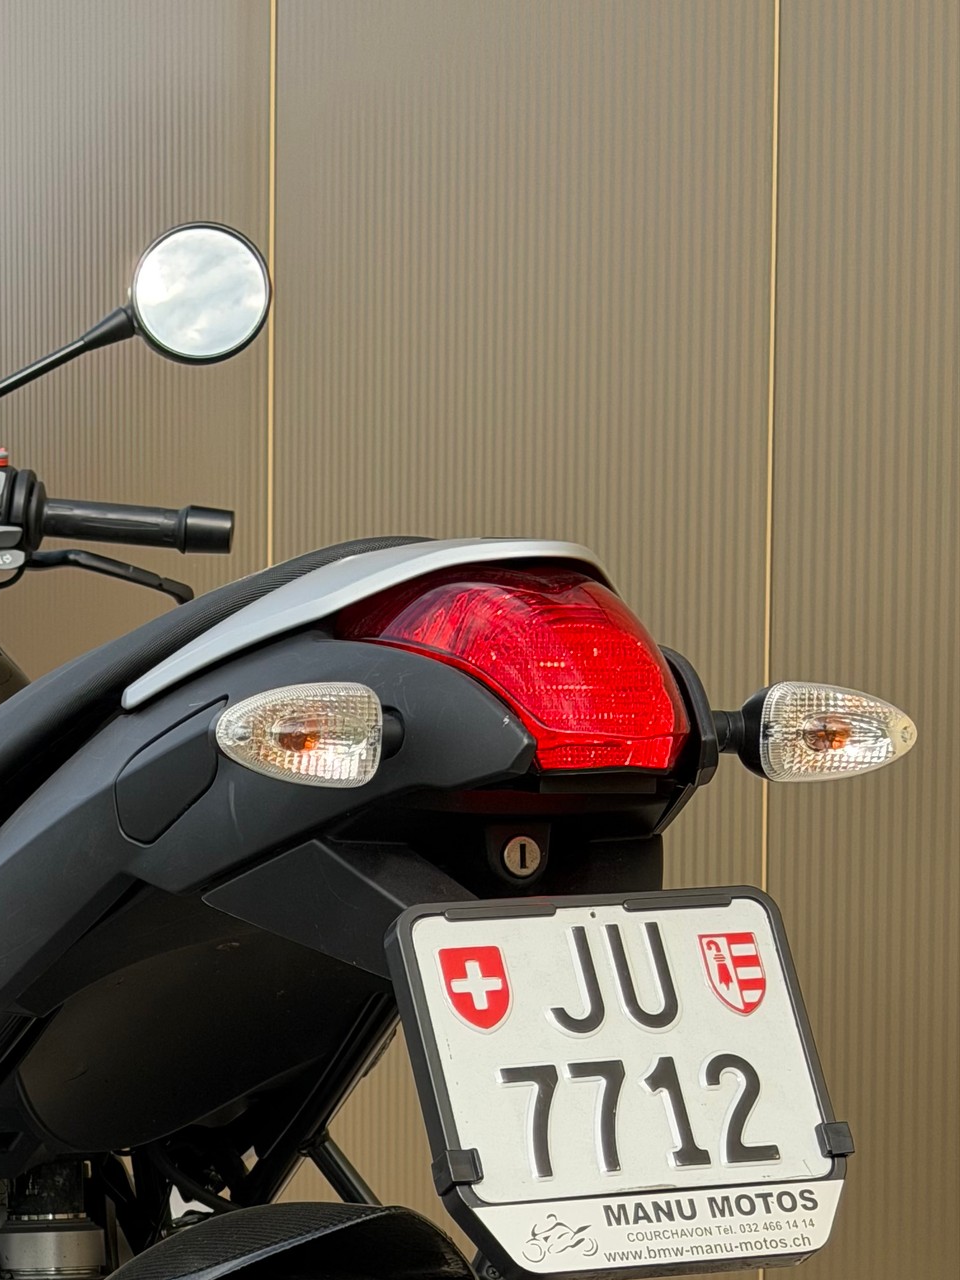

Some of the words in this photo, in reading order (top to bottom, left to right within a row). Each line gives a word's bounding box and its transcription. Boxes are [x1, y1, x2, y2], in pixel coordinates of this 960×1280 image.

[550, 921, 680, 1035] JU
[498, 1053, 782, 1179] 7712
[602, 1198, 698, 1228] MANU
[707, 1188, 819, 1219] MOTOS
[603, 1233, 812, 1263] www.bmw-manu-motos.ch
[626, 1226, 713, 1243] COURCHAVON
[739, 1222, 760, 1234] 032
[762, 1220, 783, 1232] 466
[785, 1219, 799, 1231] 14
[802, 1218, 816, 1229] 14
